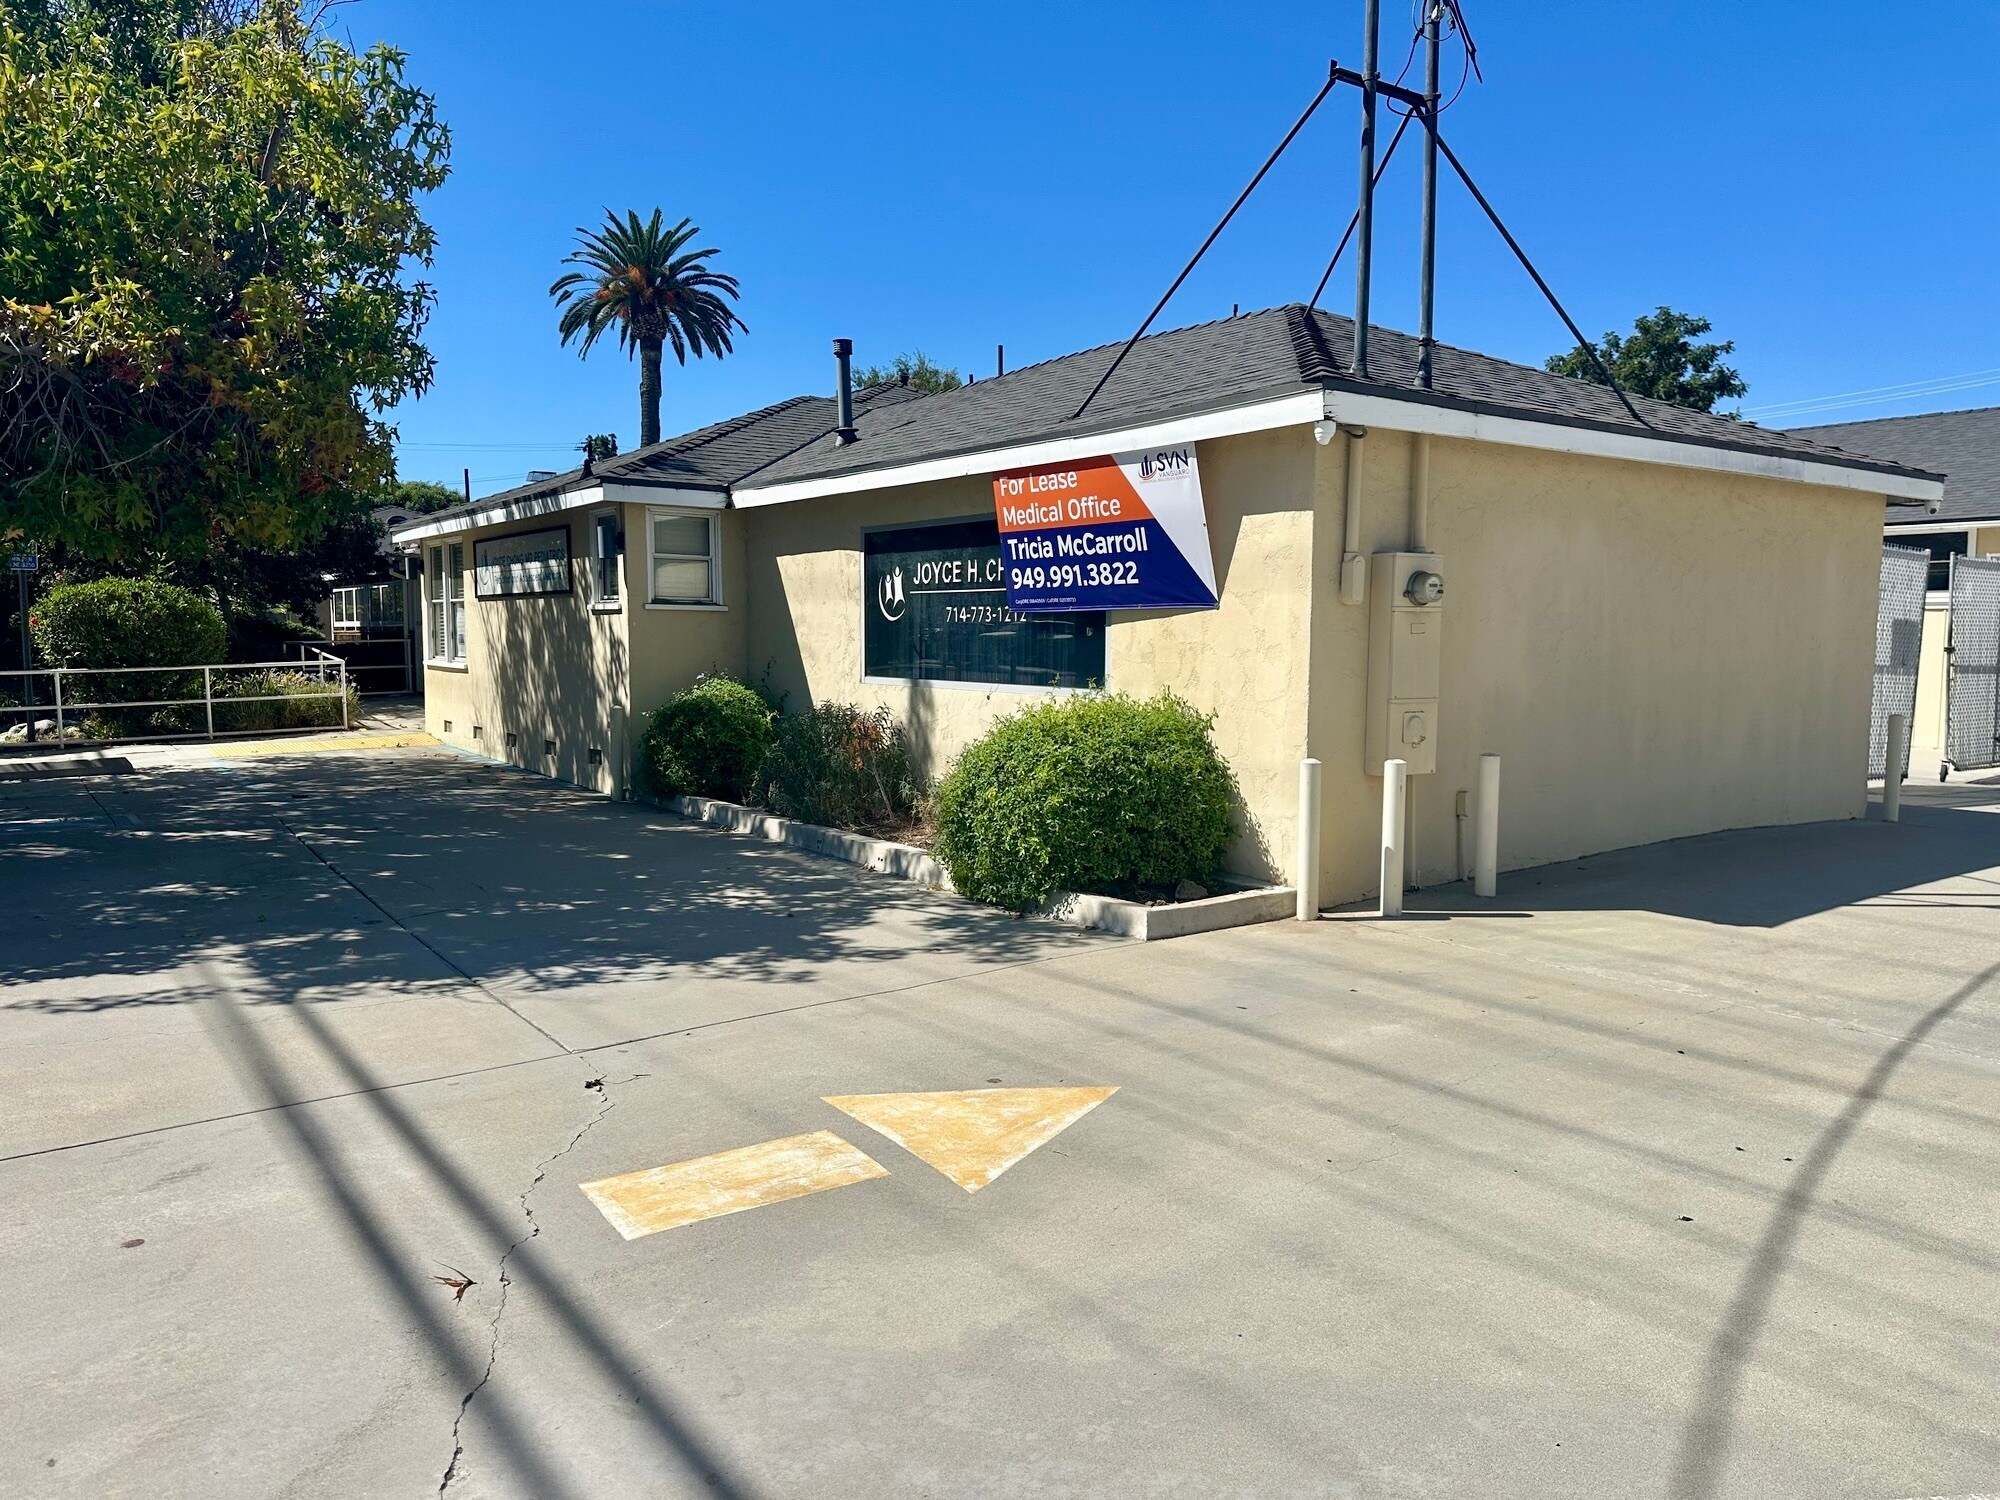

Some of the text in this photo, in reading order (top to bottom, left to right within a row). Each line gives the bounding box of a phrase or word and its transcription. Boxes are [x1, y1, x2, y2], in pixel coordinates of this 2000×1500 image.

[1156, 449, 1189, 472] SVN
[1158, 468, 1190, 478] VANGUARD
[999, 471, 1078, 497] For Lease
[1002, 495, 1122, 526] Medical Office
[1007, 526, 1148, 560] Tricia McCarroll
[913, 560, 962, 584] JOYCE
[967, 559, 982, 583] H.
[1011, 561, 1140, 590] 949.991.3822
[946, 606, 1027, 623] 714-773-1212
